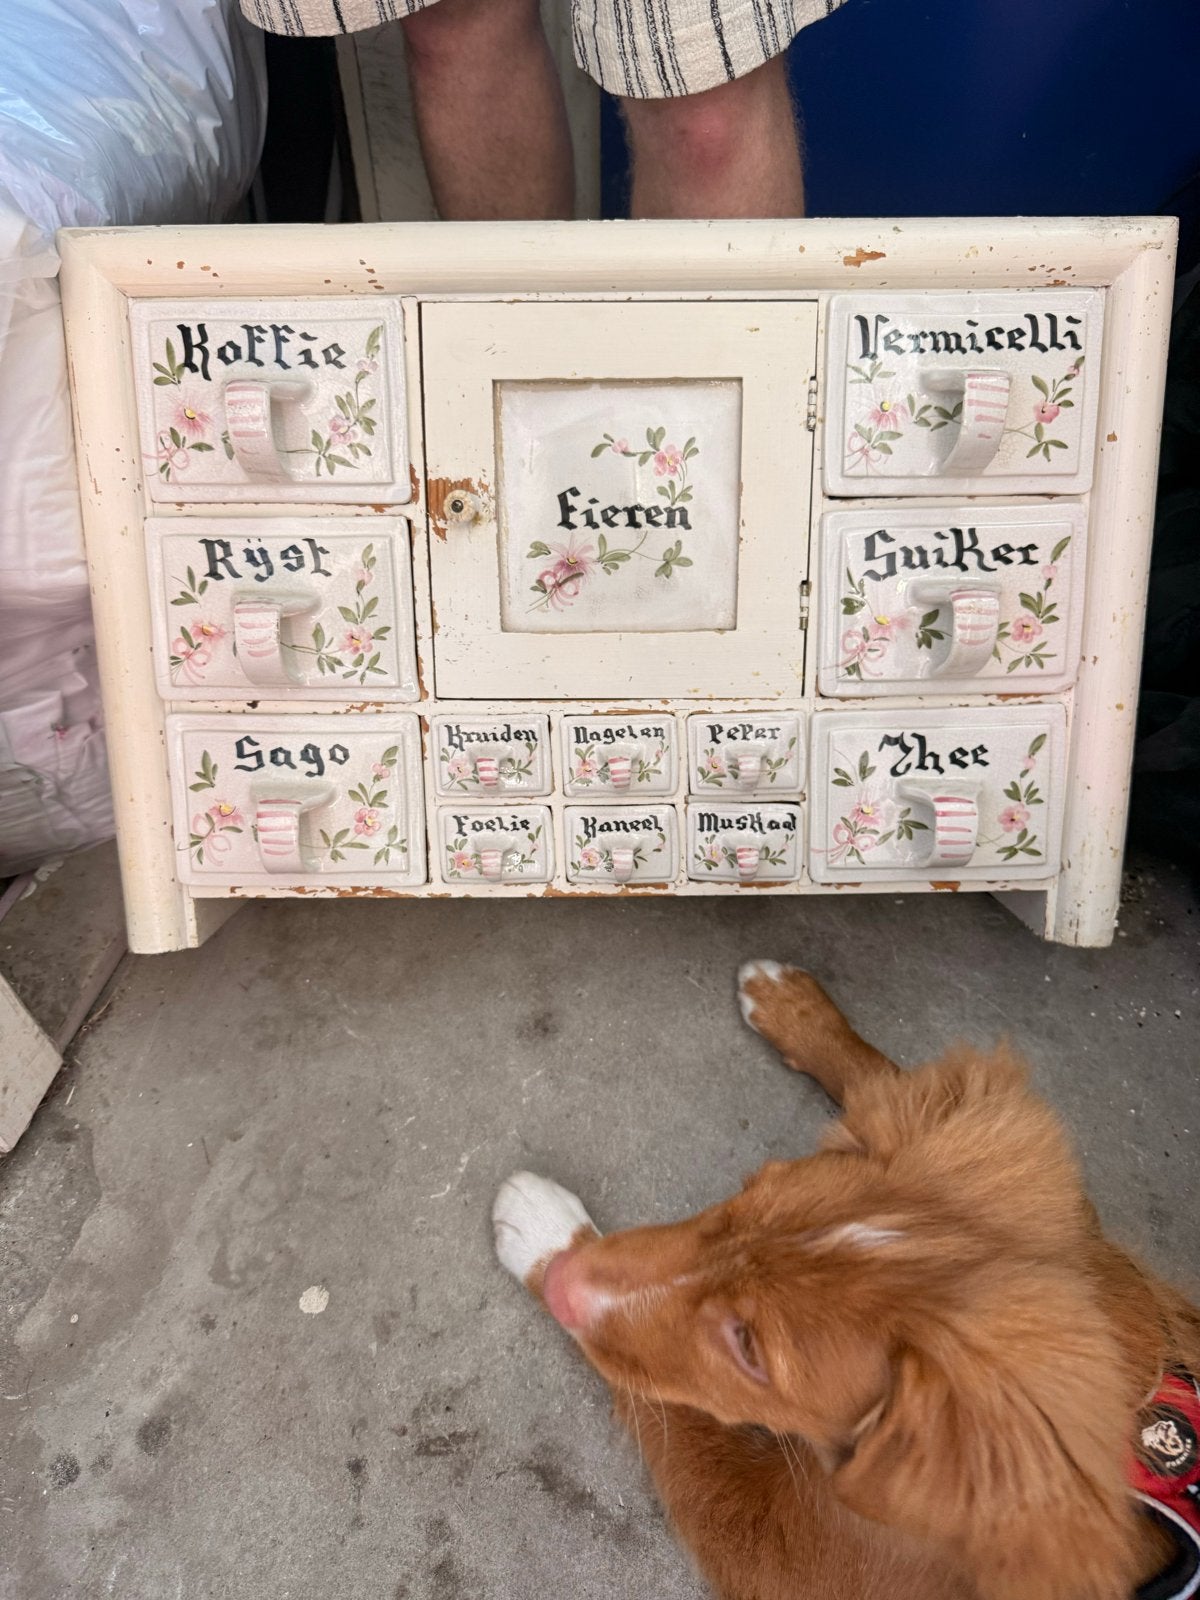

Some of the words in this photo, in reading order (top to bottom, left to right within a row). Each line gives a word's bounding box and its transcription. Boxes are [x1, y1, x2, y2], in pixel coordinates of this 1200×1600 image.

[854, 313, 1082, 360] Vermicelli
[557, 486, 692, 531] Eieren
[444, 724, 538, 751] Kruiden
[573, 725, 665, 744] Nagelen
[234, 735, 349, 777] Sago
[878, 732, 990, 777] Thee
[452, 815, 530, 836] Foelie
[580, 814, 663, 838] Kaneel
